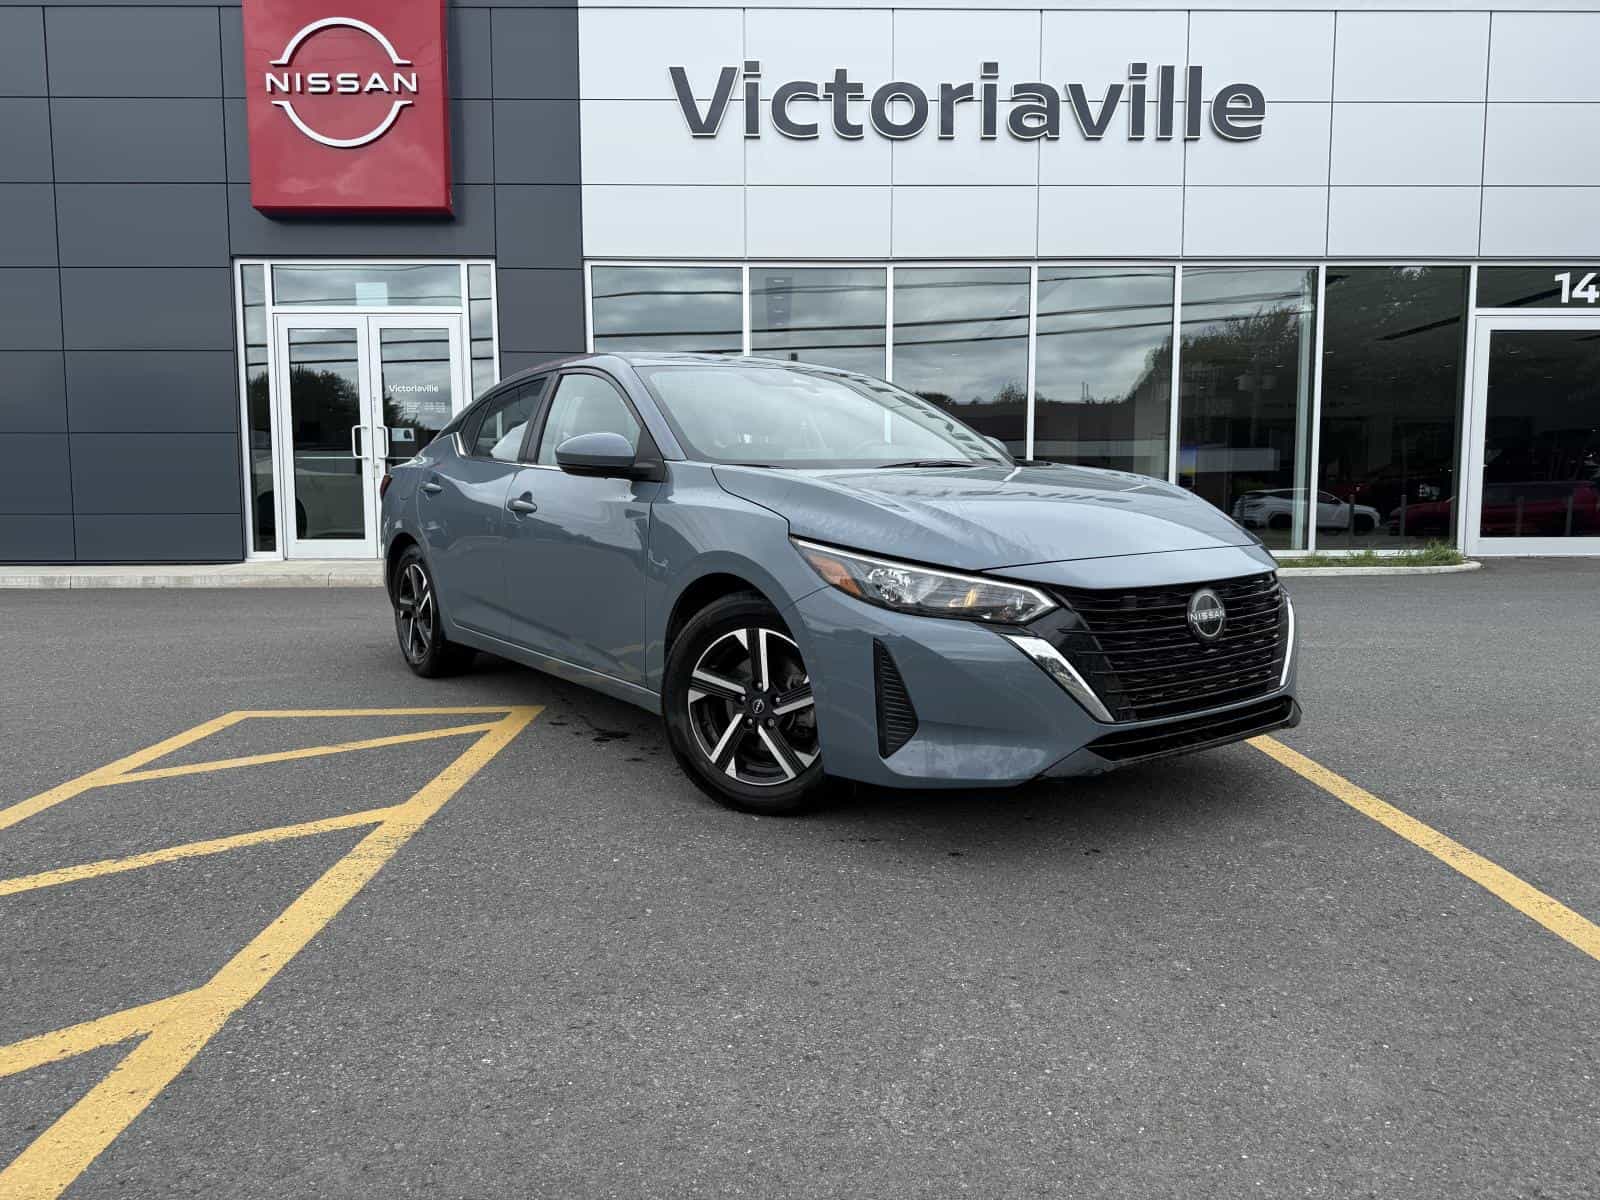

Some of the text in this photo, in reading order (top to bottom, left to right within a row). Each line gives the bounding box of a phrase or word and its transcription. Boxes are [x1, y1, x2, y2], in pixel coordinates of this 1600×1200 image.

[265, 72, 417, 93] NISSAN
[669, 60, 1266, 141] Victoriaville
[1554, 272, 1600, 303] 14
[388, 384, 440, 392] Victoriaville
[1190, 608, 1225, 621] NISSAN
